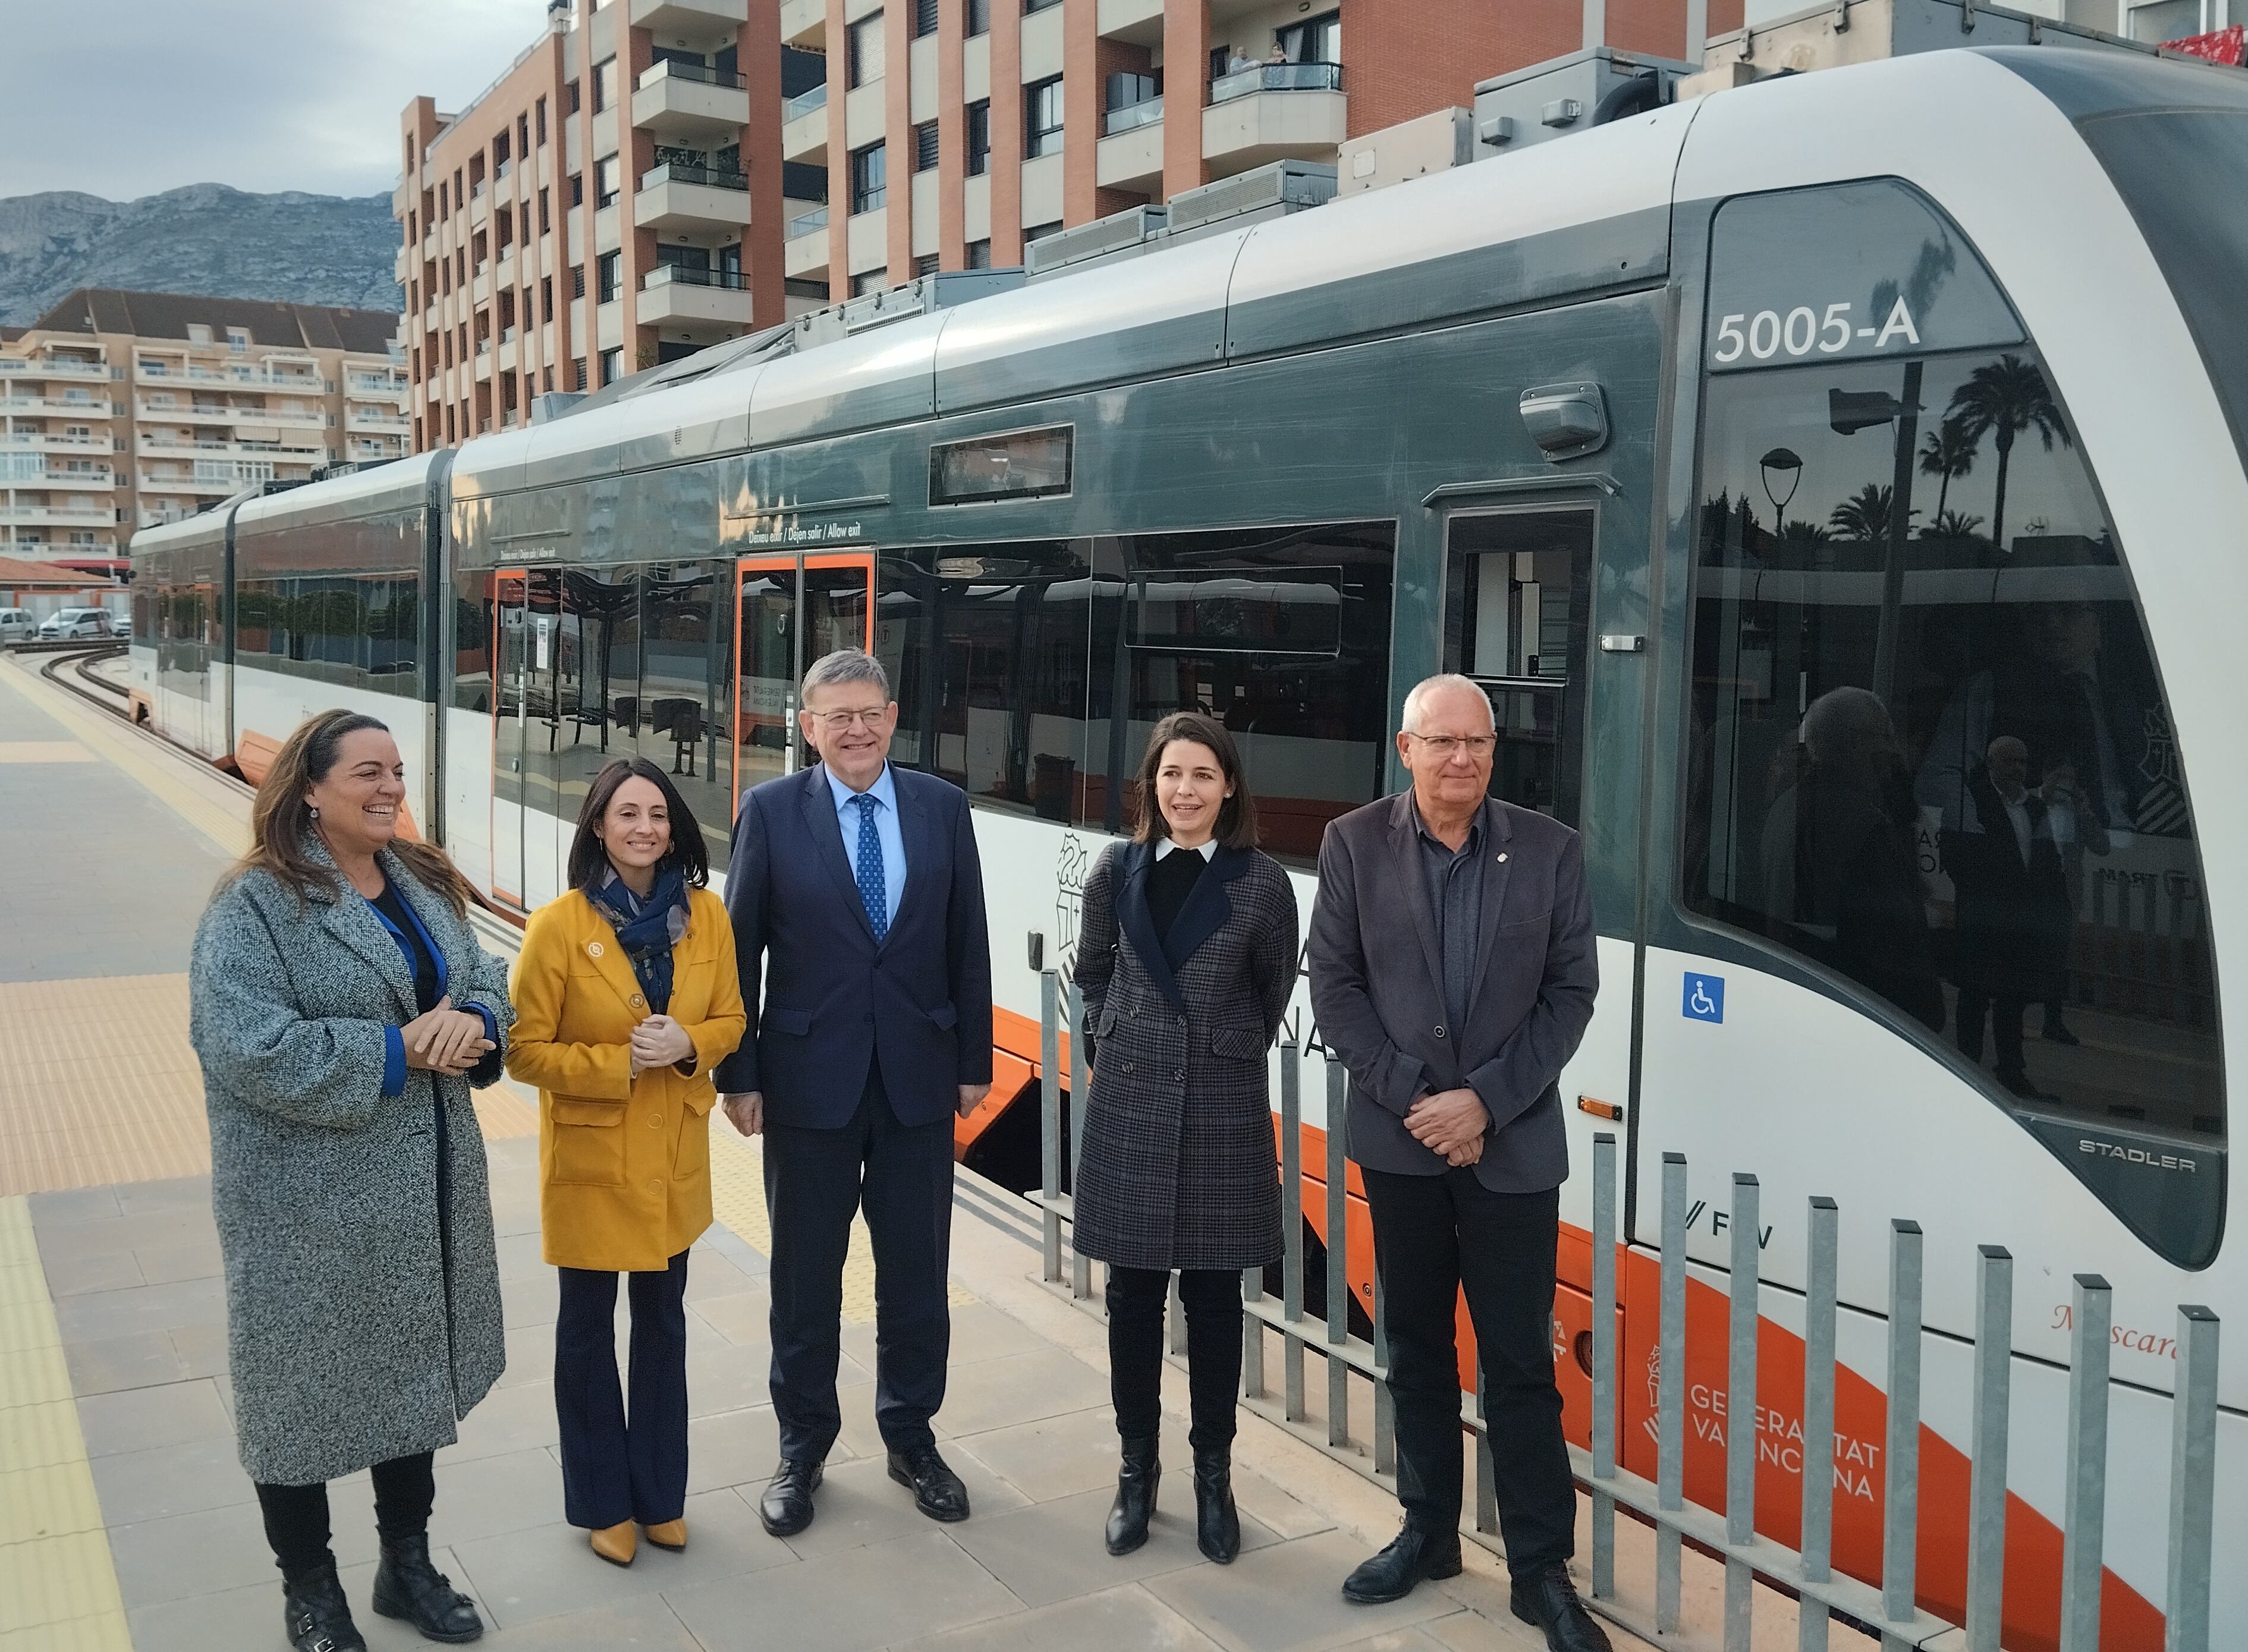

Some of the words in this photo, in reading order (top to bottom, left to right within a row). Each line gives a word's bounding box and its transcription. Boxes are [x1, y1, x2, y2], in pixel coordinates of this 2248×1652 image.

[1715, 295, 1920, 362] 5005-A
[749, 530, 768, 543] Deixeu
[788, 527, 806, 543] Dejen
[807, 524, 822, 540] salir
[828, 523, 846, 538] Allow
[848, 521, 860, 537] exit
[2079, 1140, 2196, 1173] STADLER
[1712, 1210, 1773, 1250] FV
[2051, 1305, 2177, 1360] Mscar
[1690, 1384, 1880, 1469] GEERATAT
[1692, 1414, 1874, 1502] VANCNA
